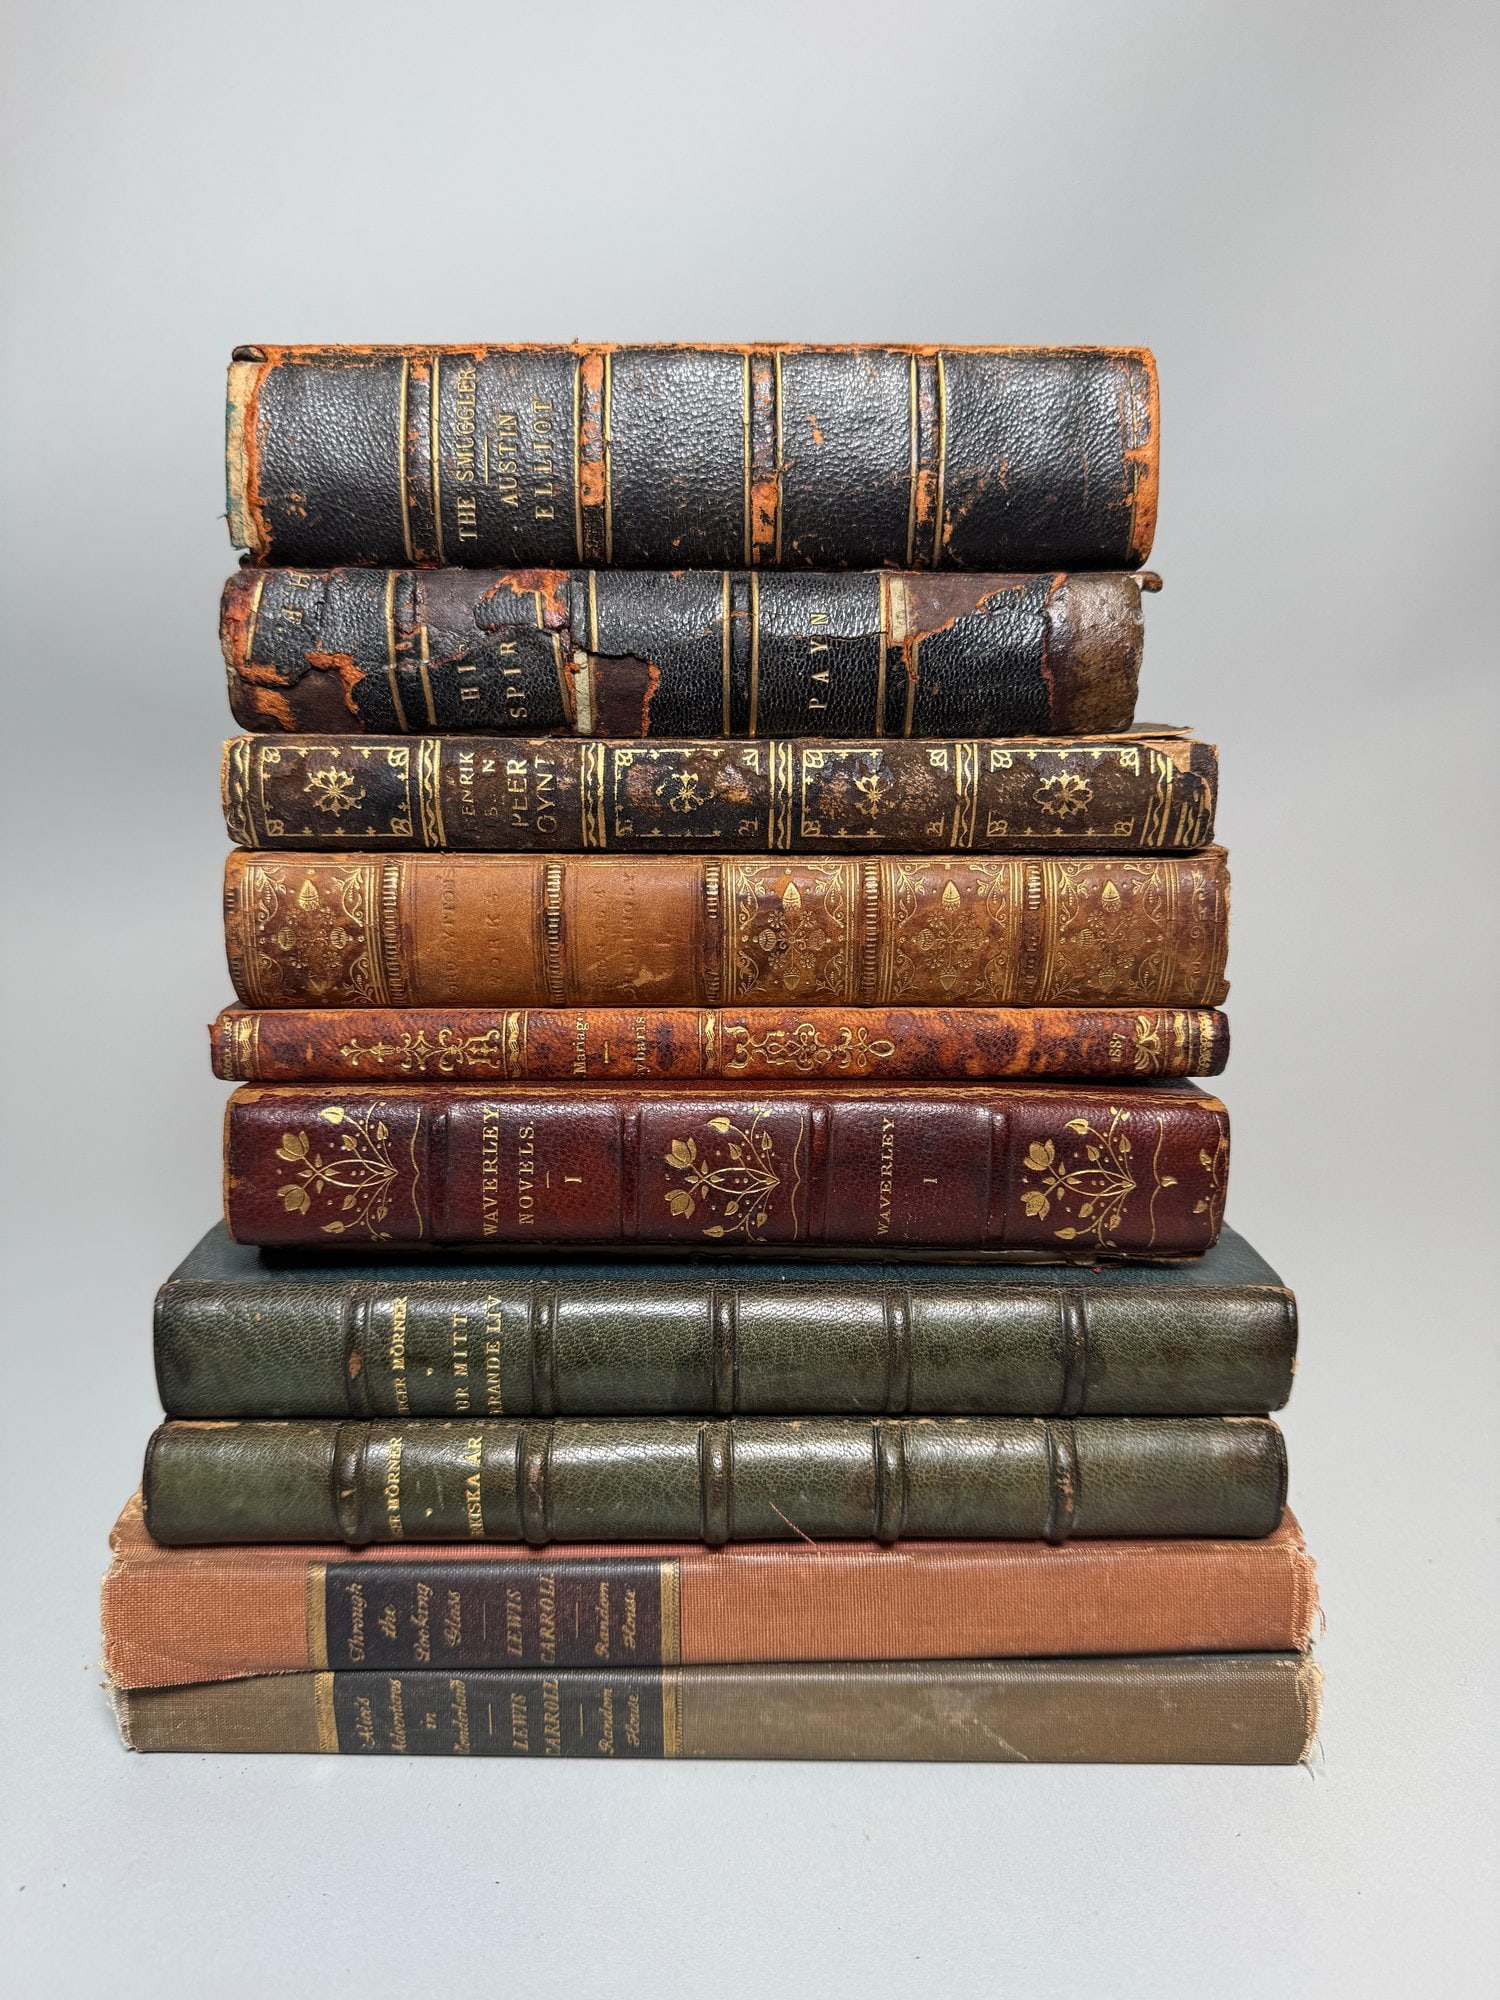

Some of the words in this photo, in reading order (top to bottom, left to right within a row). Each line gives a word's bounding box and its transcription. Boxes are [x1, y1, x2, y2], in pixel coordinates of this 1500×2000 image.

[454, 366, 477, 482] SMUGGLER
[531, 396, 555, 520] ELLIOT
[497, 411, 519, 507] AUSTIN
[455, 496, 478, 542] THE
[808, 612, 829, 711] PAYN
[459, 752, 476, 817] ENRIK
[505, 759, 530, 828] PEER
[533, 753, 557, 834] GYNT
[1109, 1032, 1126, 1062] 1887
[482, 1105, 500, 1236] WAVERLEY
[518, 1119, 535, 1226] NOVELS.
[876, 1116, 895, 1236] WAVERLEY
[452, 1312, 469, 1377] MITT
[484, 1294, 502, 1333] LIV
[345, 1583, 366, 1663] Through
[378, 1604, 398, 1640] the
[413, 1582, 433, 1663] Looking
[444, 1589, 463, 1647] Glass
[505, 1588, 523, 1657] LEWIS
[593, 1580, 610, 1659] Random
[622, 1587, 637, 1650] House
[353, 1696, 376, 1746] Alice's
[419, 1711, 438, 1731] in
[511, 1692, 529, 1752] LEWIS
[598, 1686, 615, 1755] Random
[626, 1692, 641, 1747] House
